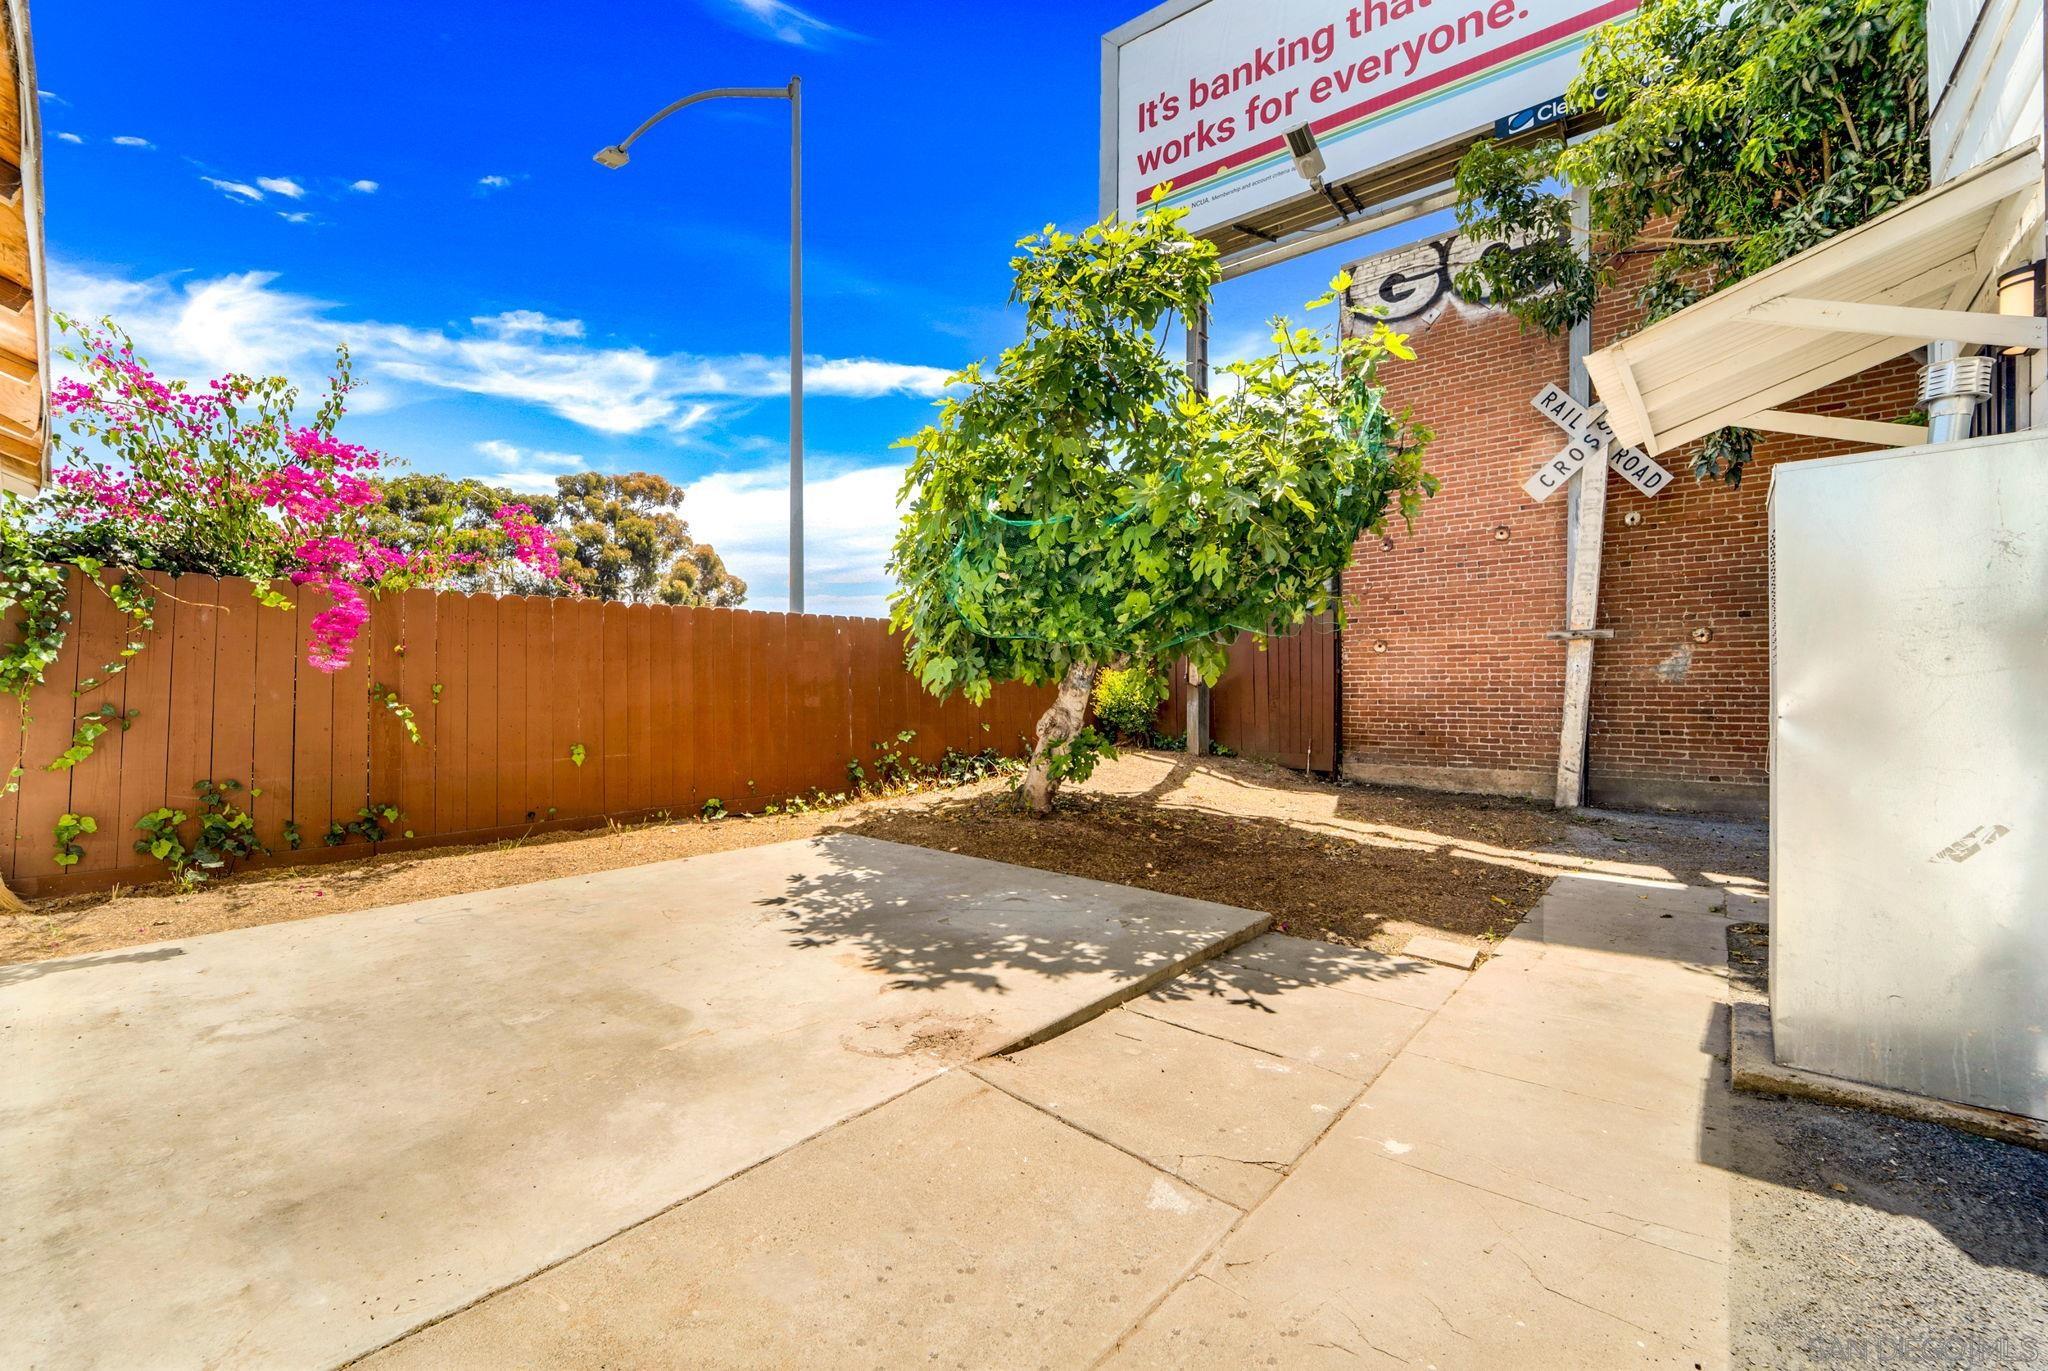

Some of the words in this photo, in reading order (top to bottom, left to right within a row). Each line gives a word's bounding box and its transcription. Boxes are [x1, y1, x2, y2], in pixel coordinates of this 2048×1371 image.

[1138, 92, 1180, 133] It’s
[1190, 23, 1335, 110] banking
[1346, 0, 1434, 39] tha
[1136, 116, 1237, 176] works
[1245, 88, 1299, 132] for
[1309, 0, 1529, 104] everyone.
[1537, 101, 1578, 121] Cle
[1211, 186, 1241, 201] Membership
[1241, 182, 1251, 190] and
[1251, 174, 1272, 187] account
[1541, 391, 1583, 430] RAIL
[1539, 420, 1613, 488] CROSS
[1611, 447, 1663, 489] ROAD
